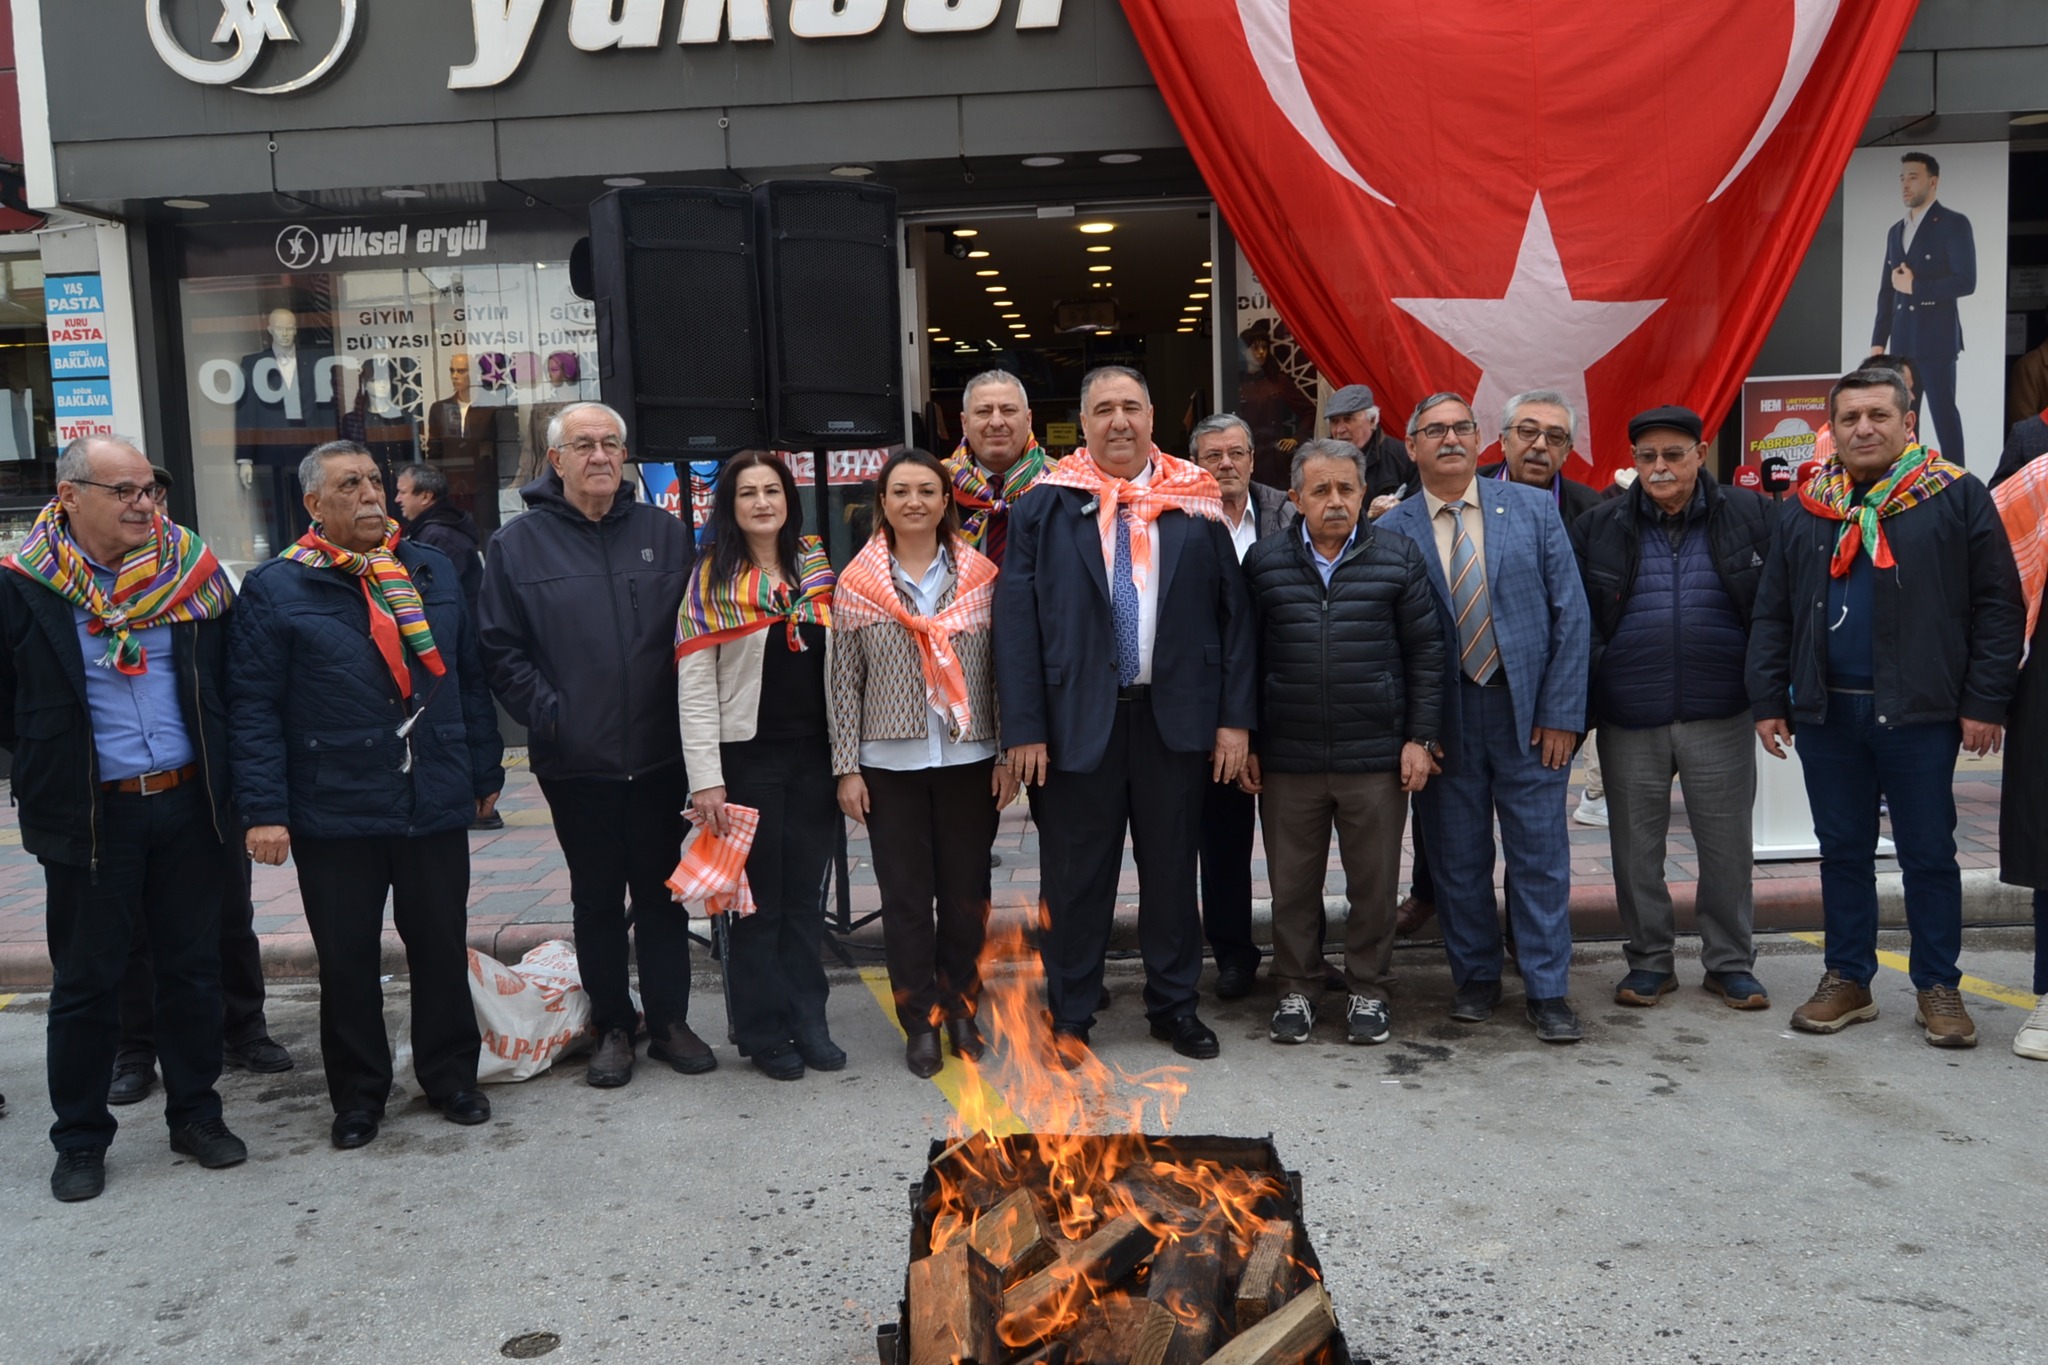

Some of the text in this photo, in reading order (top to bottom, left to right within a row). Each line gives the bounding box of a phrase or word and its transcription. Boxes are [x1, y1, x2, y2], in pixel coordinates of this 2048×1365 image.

[320, 219, 488, 264] yüksel ergül
[63, 283, 83, 296] YAŞ
[48, 296, 101, 311] PASTA
[359, 308, 414, 325] GİYİM
[453, 306, 509, 322] GİYİM
[64, 318, 88, 327] KURU
[52, 328, 103, 341] PASTA
[347, 333, 429, 350] DÜNYASI
[441, 330, 524, 347] DÜNYASI
[54, 356, 106, 369] BAKLAVA
[57, 394, 109, 407] BAKLAVA
[1760, 399, 1782, 412] HEM
